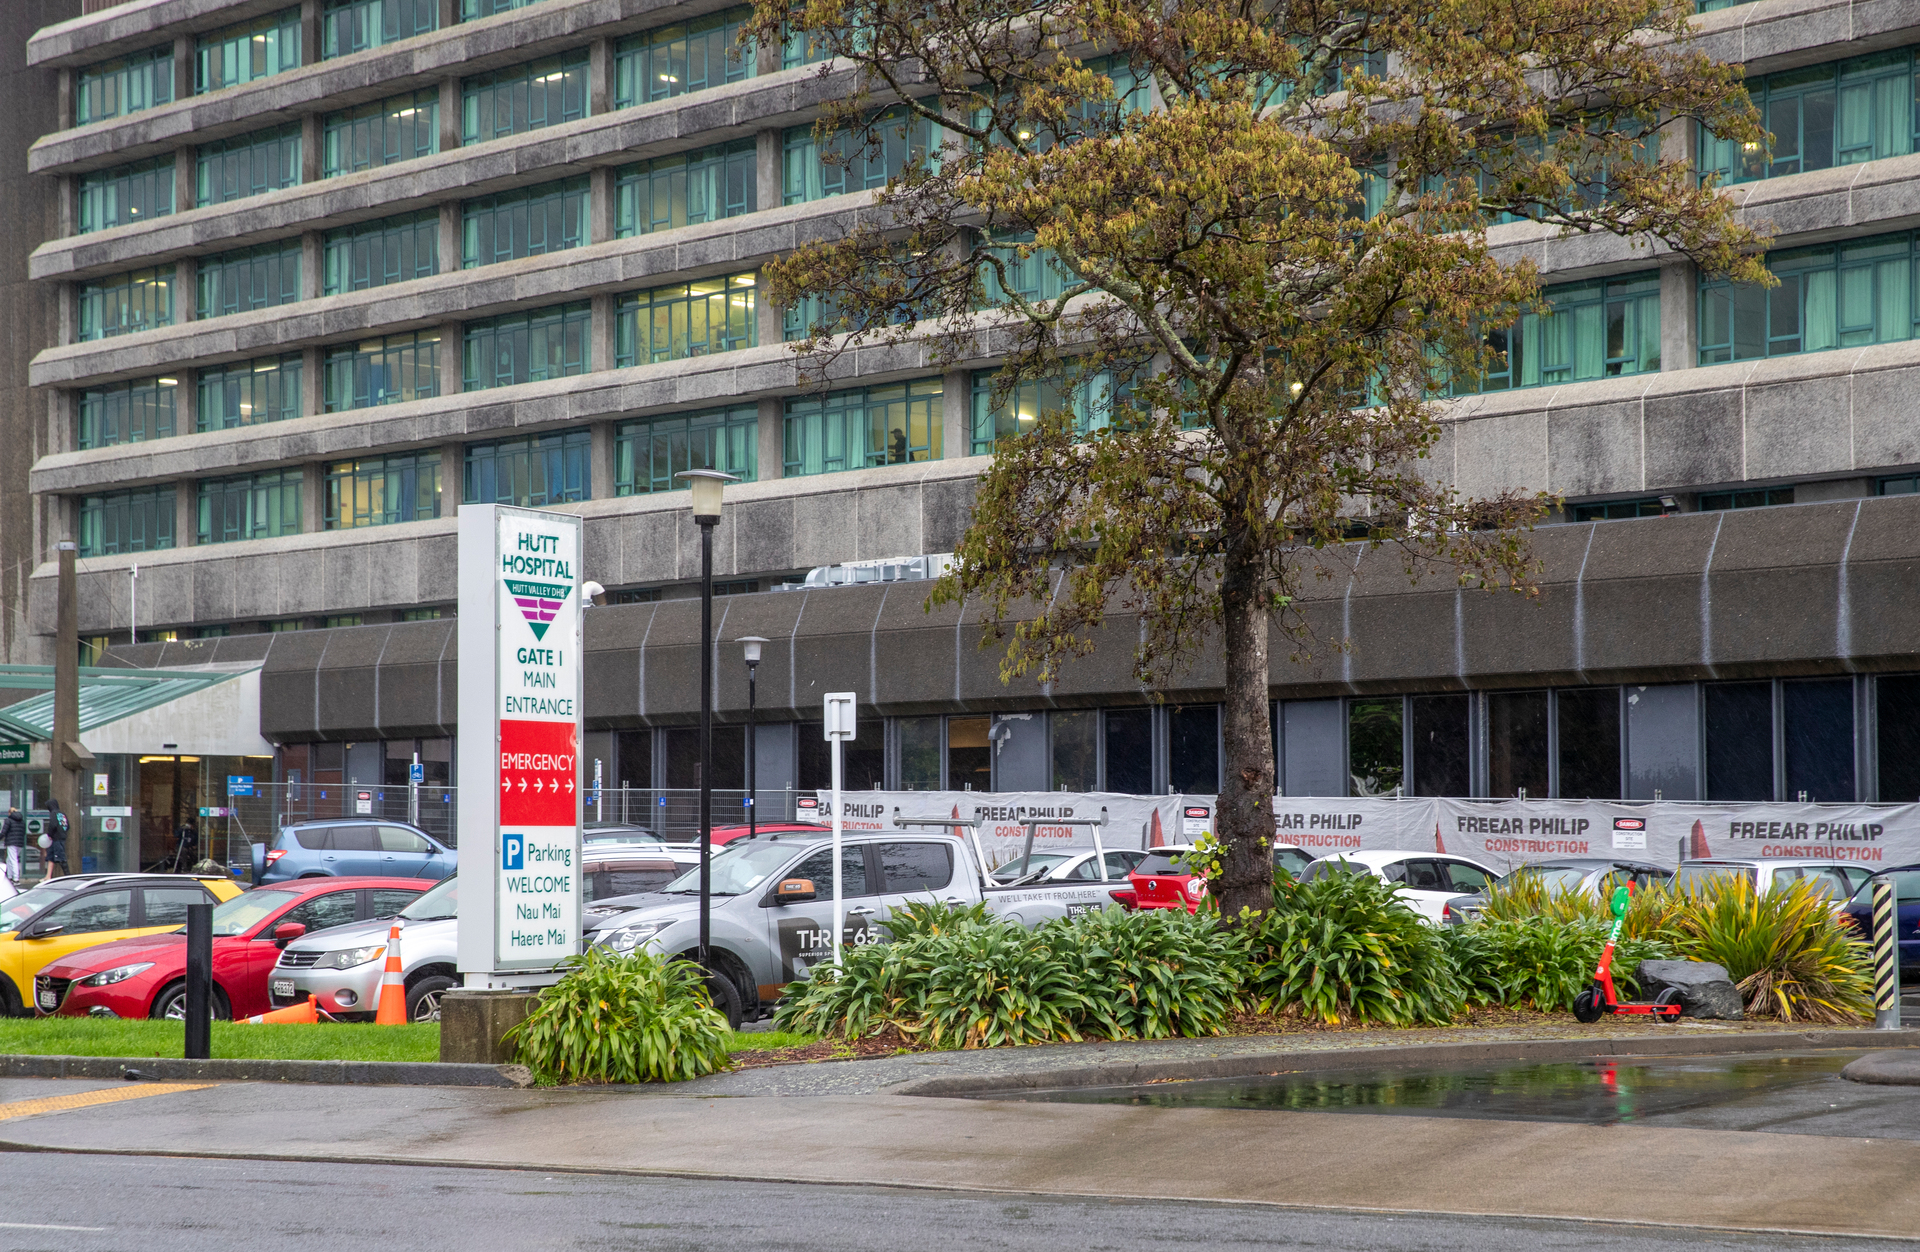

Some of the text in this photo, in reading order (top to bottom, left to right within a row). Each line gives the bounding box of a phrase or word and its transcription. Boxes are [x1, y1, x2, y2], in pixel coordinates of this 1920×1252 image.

[518, 532, 559, 554] HUTT
[503, 554, 573, 579] HOSPITAL
[512, 583, 528, 594] HUTT
[528, 585, 551, 596] VALLEY
[517, 647, 554, 666] GATE
[523, 670, 556, 688] MAIN
[506, 696, 573, 715] ENTRANCE
[501, 752, 574, 771] EMERGENCY
[844, 803, 884, 818] PHILIP
[1310, 814, 1362, 829] PHILIP
[1457, 816, 1590, 835] FREEAR PHILIP
[995, 826, 1073, 838] CONSTUCTION
[1275, 833, 1361, 848] ONSTRUCTION
[1729, 822, 1884, 841] FREEAR PHILIP
[507, 839, 571, 867] P Parking
[1485, 839, 1588, 853] CONSTRUCTION
[1761, 845, 1882, 861] CONSTRUCTION
[507, 876, 570, 893] WELCOME
[998, 894, 1022, 903] WE'LL
[1022, 893, 1043, 902] TAKE
[517, 902, 561, 920] Nau Mai
[511, 929, 566, 946] Haere Mai
[796, 927, 879, 949] THRE65
